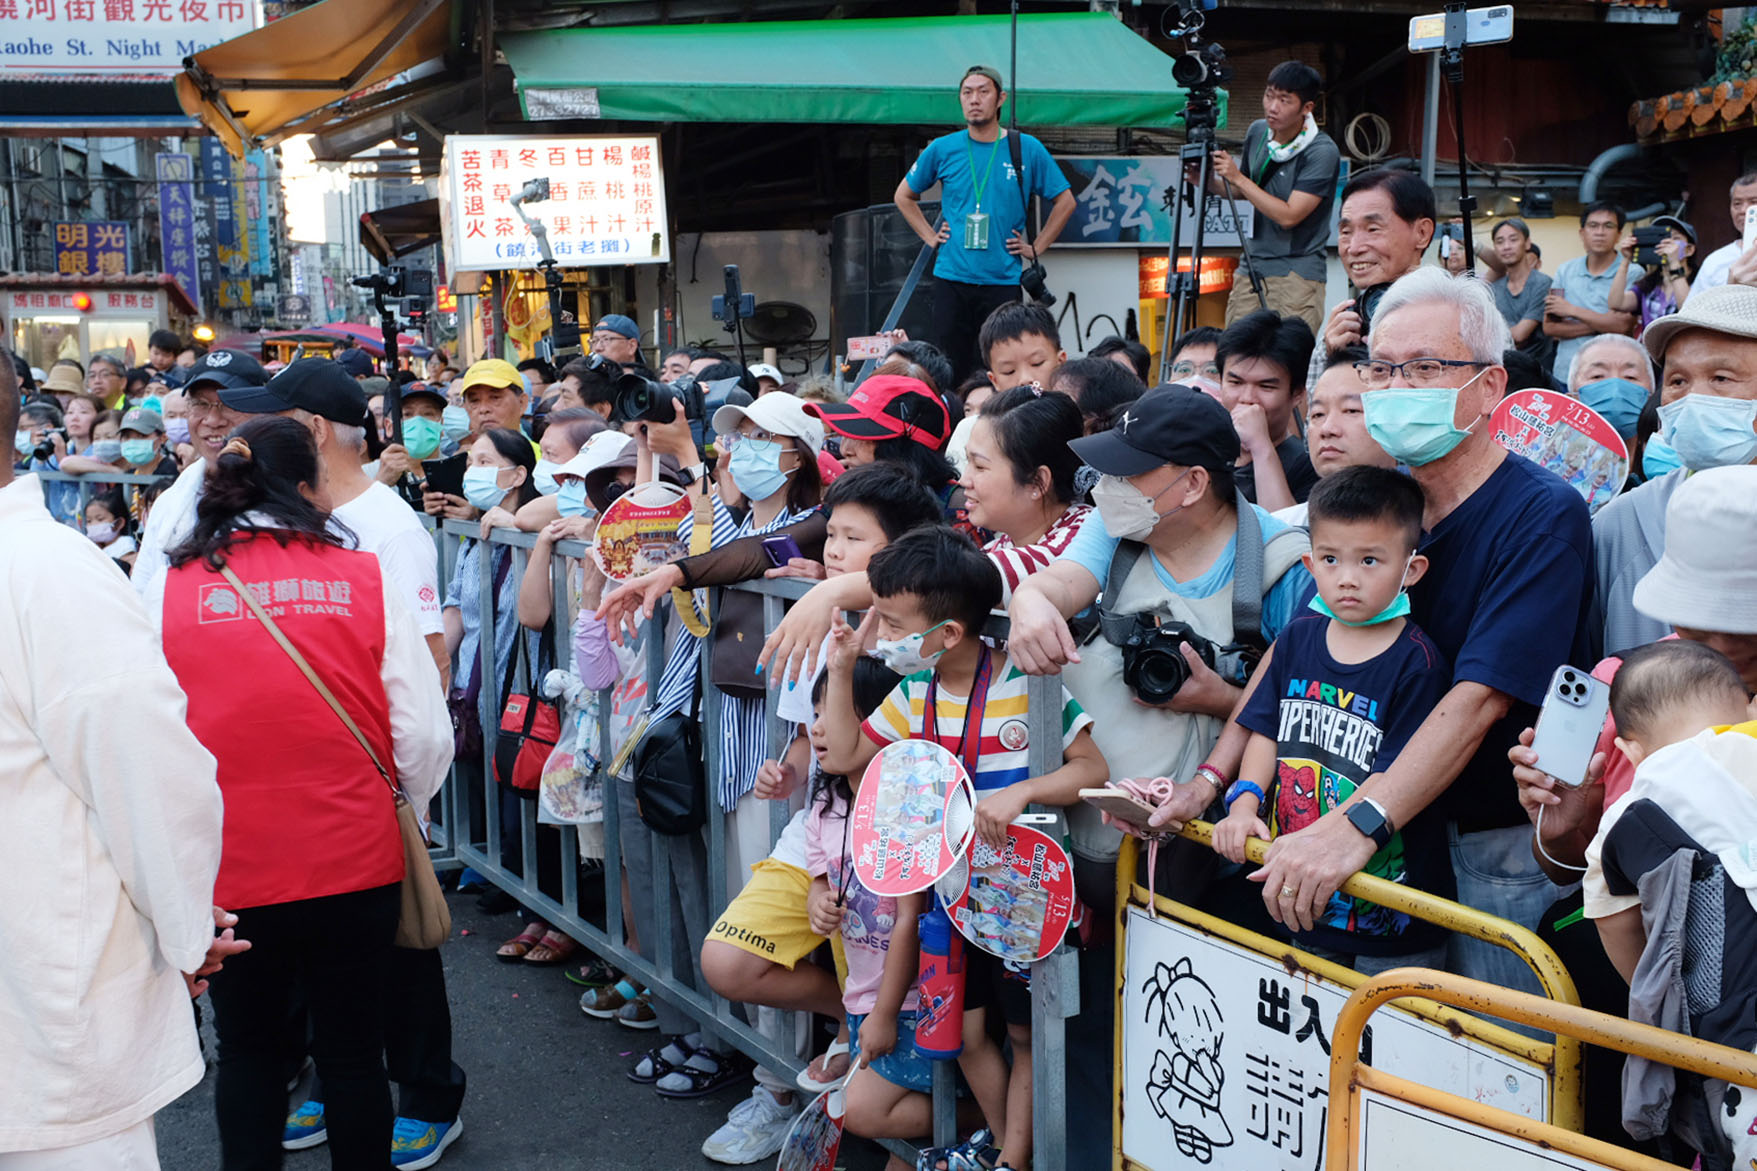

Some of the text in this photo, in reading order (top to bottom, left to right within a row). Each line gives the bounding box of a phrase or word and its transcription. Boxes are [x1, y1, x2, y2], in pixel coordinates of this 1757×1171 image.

[0, 37, 53, 56] aohe
[67, 39, 93, 56] St.
[107, 39, 161, 60] Night
[461, 149, 487, 239] 苦茶退火
[490, 149, 514, 237] 青草茶
[547, 147, 572, 236] 百香果
[576, 147, 599, 235] 甘蔗汁
[603, 145, 627, 233] 楊桃汁
[57, 224, 125, 248] 明光
[108, 293, 154, 309] 服務台
[247, 604, 352, 619] LON TRAVEL
[1287, 678, 1378, 721] MARVEL
[715, 921, 776, 954] Optima
